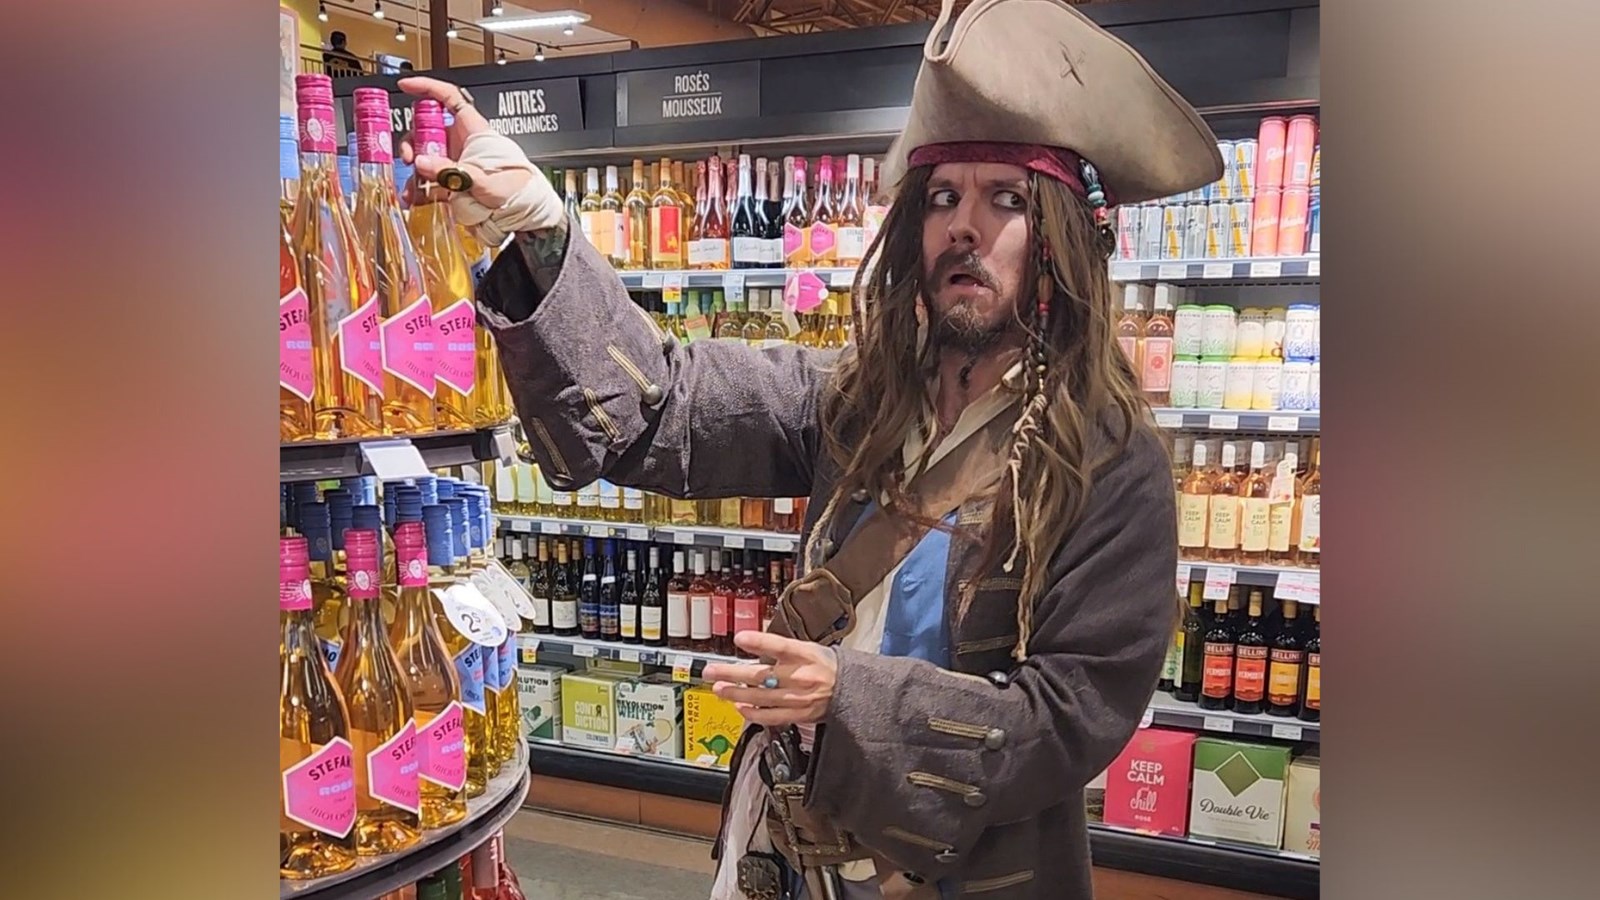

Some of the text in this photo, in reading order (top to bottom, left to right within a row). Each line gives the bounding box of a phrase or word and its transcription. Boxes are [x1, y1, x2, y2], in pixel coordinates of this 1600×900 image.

[674, 71, 710, 94] ROSÉS
[499, 89, 546, 116] AUTRES
[662, 96, 722, 118] MOUSSEUX
[403, 106, 415, 132] P
[490, 114, 558, 135] PROVENANCES
[617, 698, 665, 711] REVOLUTION
[574, 717, 609, 732] DICTION
[1130, 759, 1163, 774] KEEP
[1127, 771, 1165, 787] CALM
[1200, 798, 1271, 821] Double Vie
